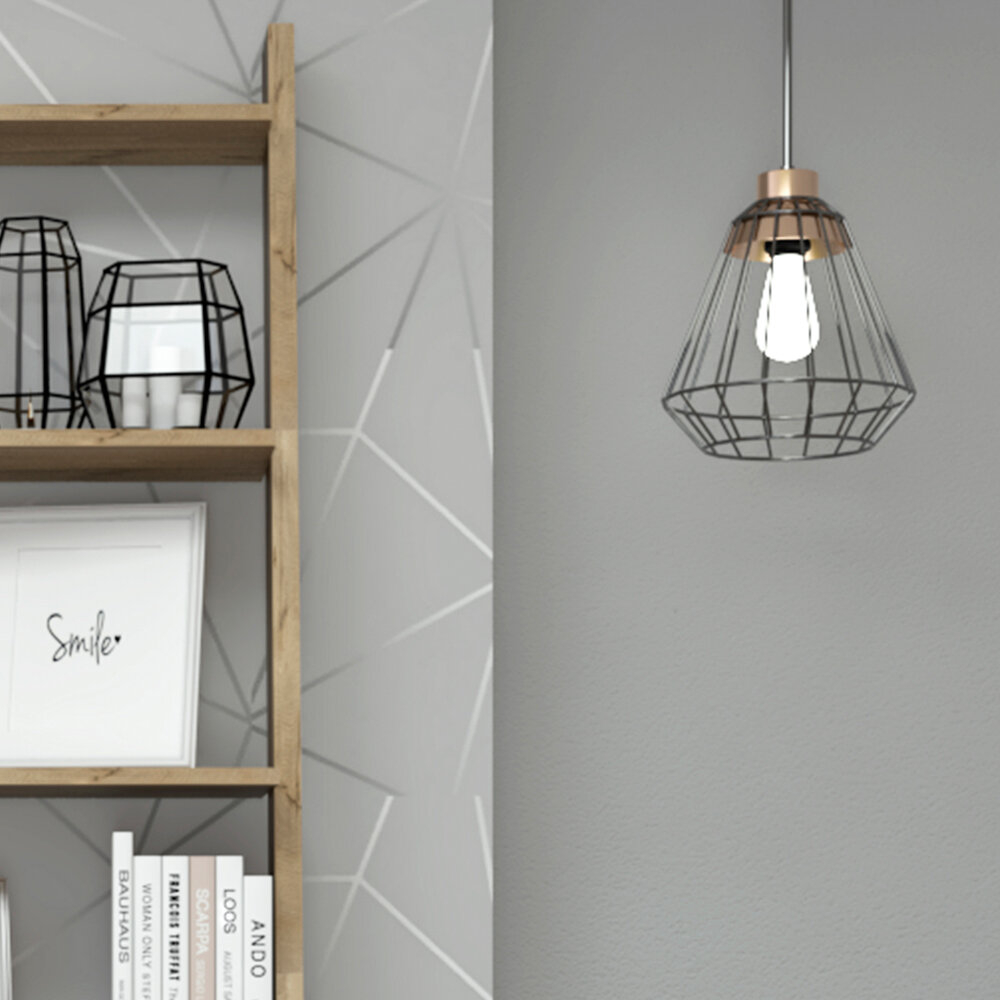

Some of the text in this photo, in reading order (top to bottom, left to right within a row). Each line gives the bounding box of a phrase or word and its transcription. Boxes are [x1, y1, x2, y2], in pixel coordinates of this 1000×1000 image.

[46, 609, 116, 665] Smile
[119, 869, 129, 963] BAUHAUS
[142, 884, 152, 969] WOMAN ONLY
[169, 873, 179, 982] FRANCOIS TRUFFAT
[196, 888, 209, 955] SCARPA
[223, 889, 237, 934] LOOS
[223, 951, 232, 988] AUGUST
[250, 919, 266, 978] ANDO
